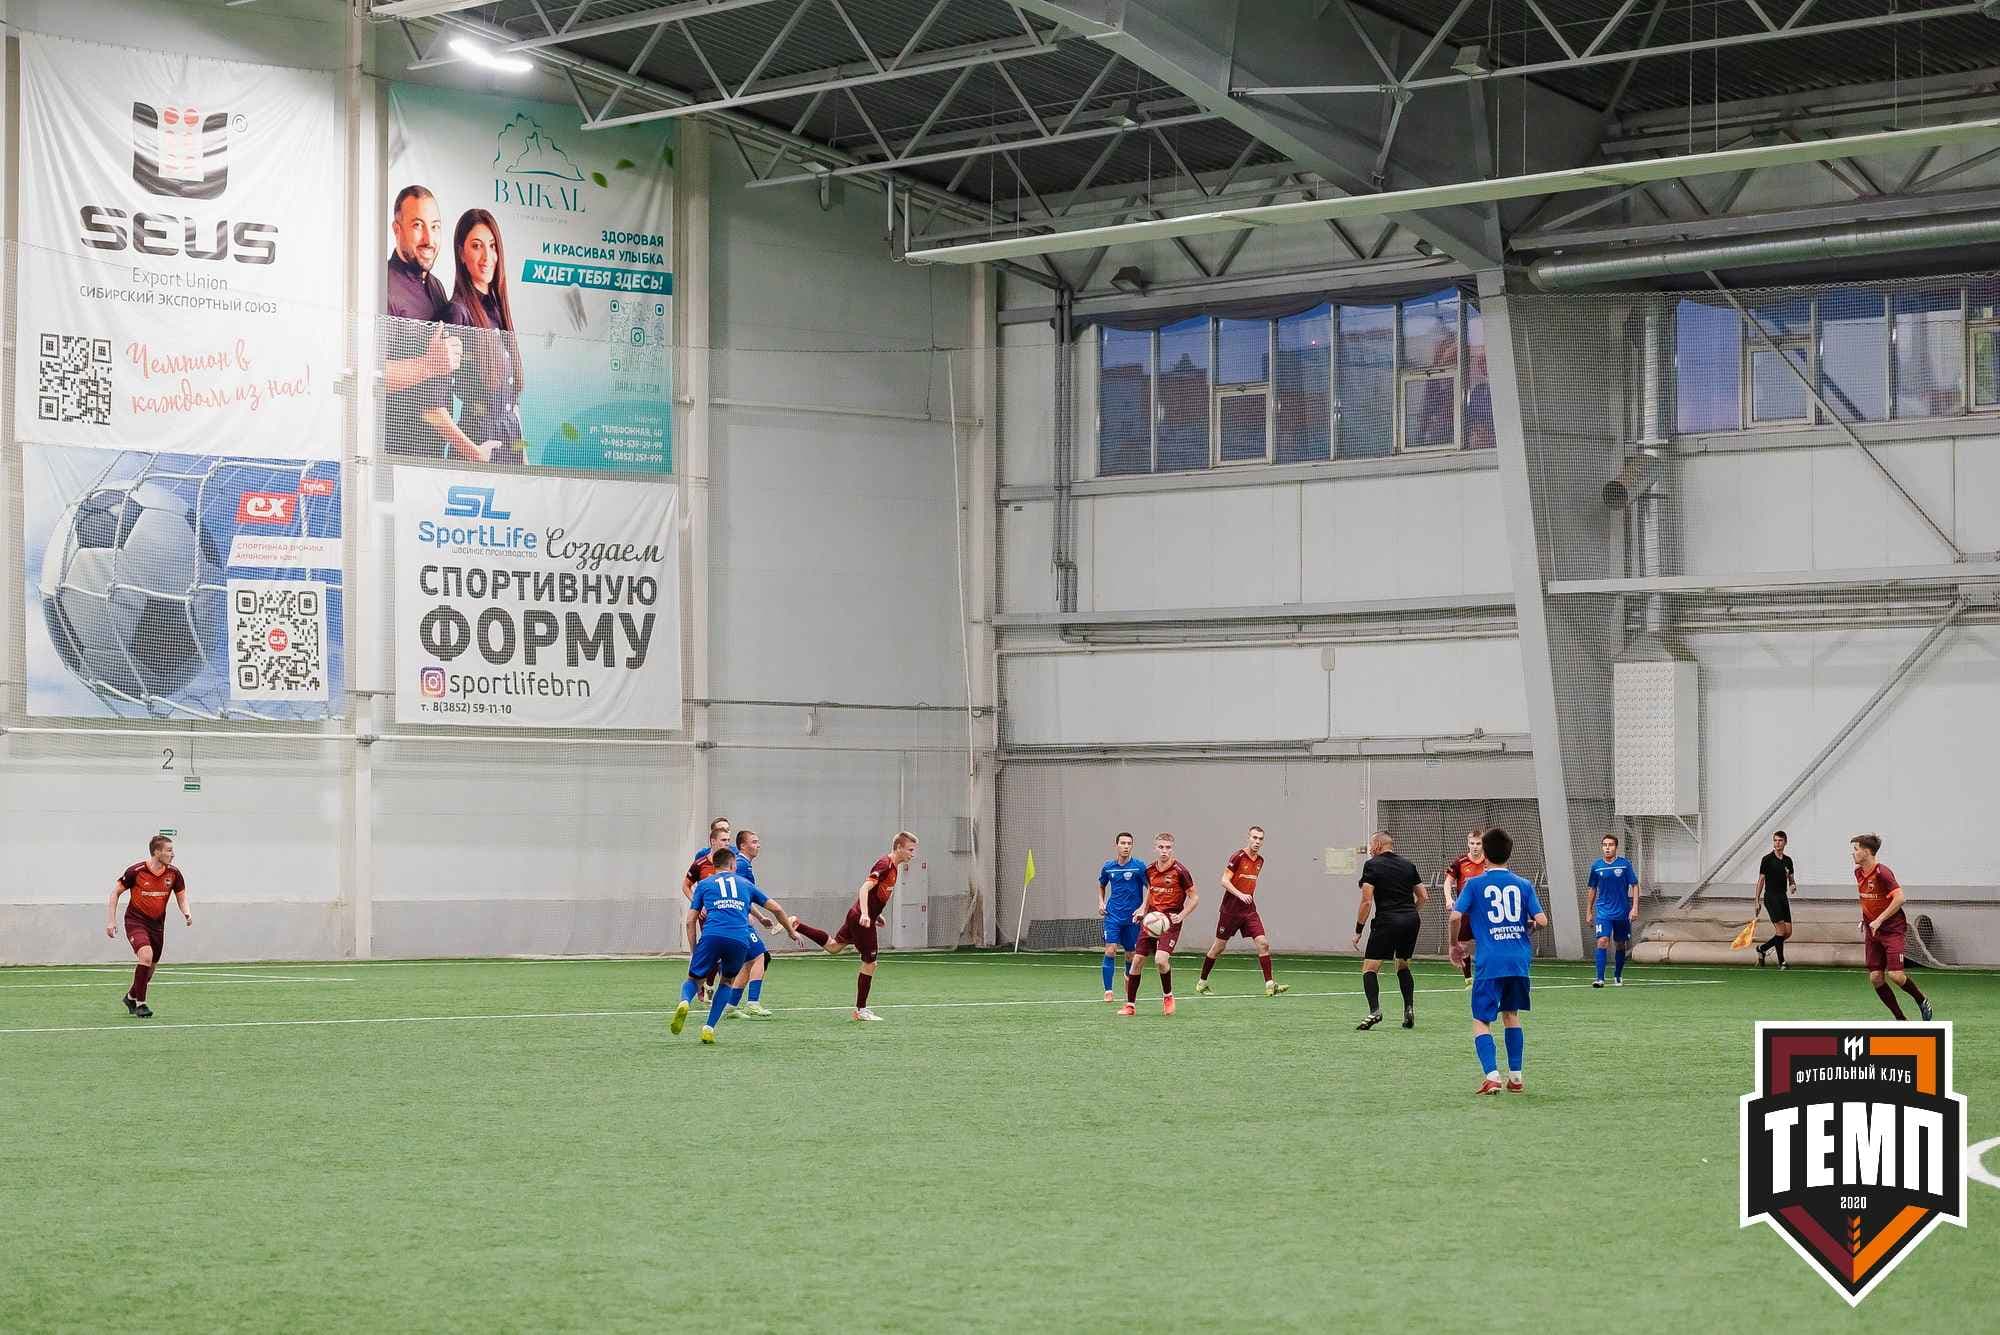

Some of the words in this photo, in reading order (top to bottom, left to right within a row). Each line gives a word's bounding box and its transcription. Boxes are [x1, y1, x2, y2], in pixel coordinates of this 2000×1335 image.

[495, 179, 586, 213] BAIKAL
[80, 205, 279, 265] SEUS
[601, 230, 664, 247] ЗДОРОВАЯ
[543, 242, 550, 254] И
[553, 243, 616, 260] КРАСИВАЯ
[619, 250, 664, 265] УЛЫБКА
[132, 267, 181, 288] Export
[186, 272, 228, 291] Union
[532, 264, 574, 283] ЖДЕТ
[578, 269, 611, 286] ТЕБЯ
[614, 273, 664, 290] ЗДЕСЬ!
[80, 285, 154, 304] СИБИРСКИЙ
[158, 294, 241, 312] ЭКСПОРТНЫЙ
[245, 301, 277, 313] СОЮЗ
[126, 342, 232, 379] Чемпион
[235, 338, 250, 371] в
[132, 378, 230, 414] каждом
[236, 384, 261, 411] из
[267, 364, 311, 399] нас!
[444, 485, 512, 520] SL
[418, 521, 538, 549] SportLife
[546, 526, 665, 570] Создаем
[420, 565, 657, 605] СПОРТИВНУЮ
[420, 604, 657, 669] ФОРМУ
[450, 671, 591, 699] sportlifebrn
[433, 702, 470, 713] 8(3852)
[473, 703, 512, 714] 59-11-10
[162, 748, 174, 770] 2
[715, 876, 738, 898] 11
[1484, 885, 1522, 924] 30
[750, 932, 758, 943] 8
